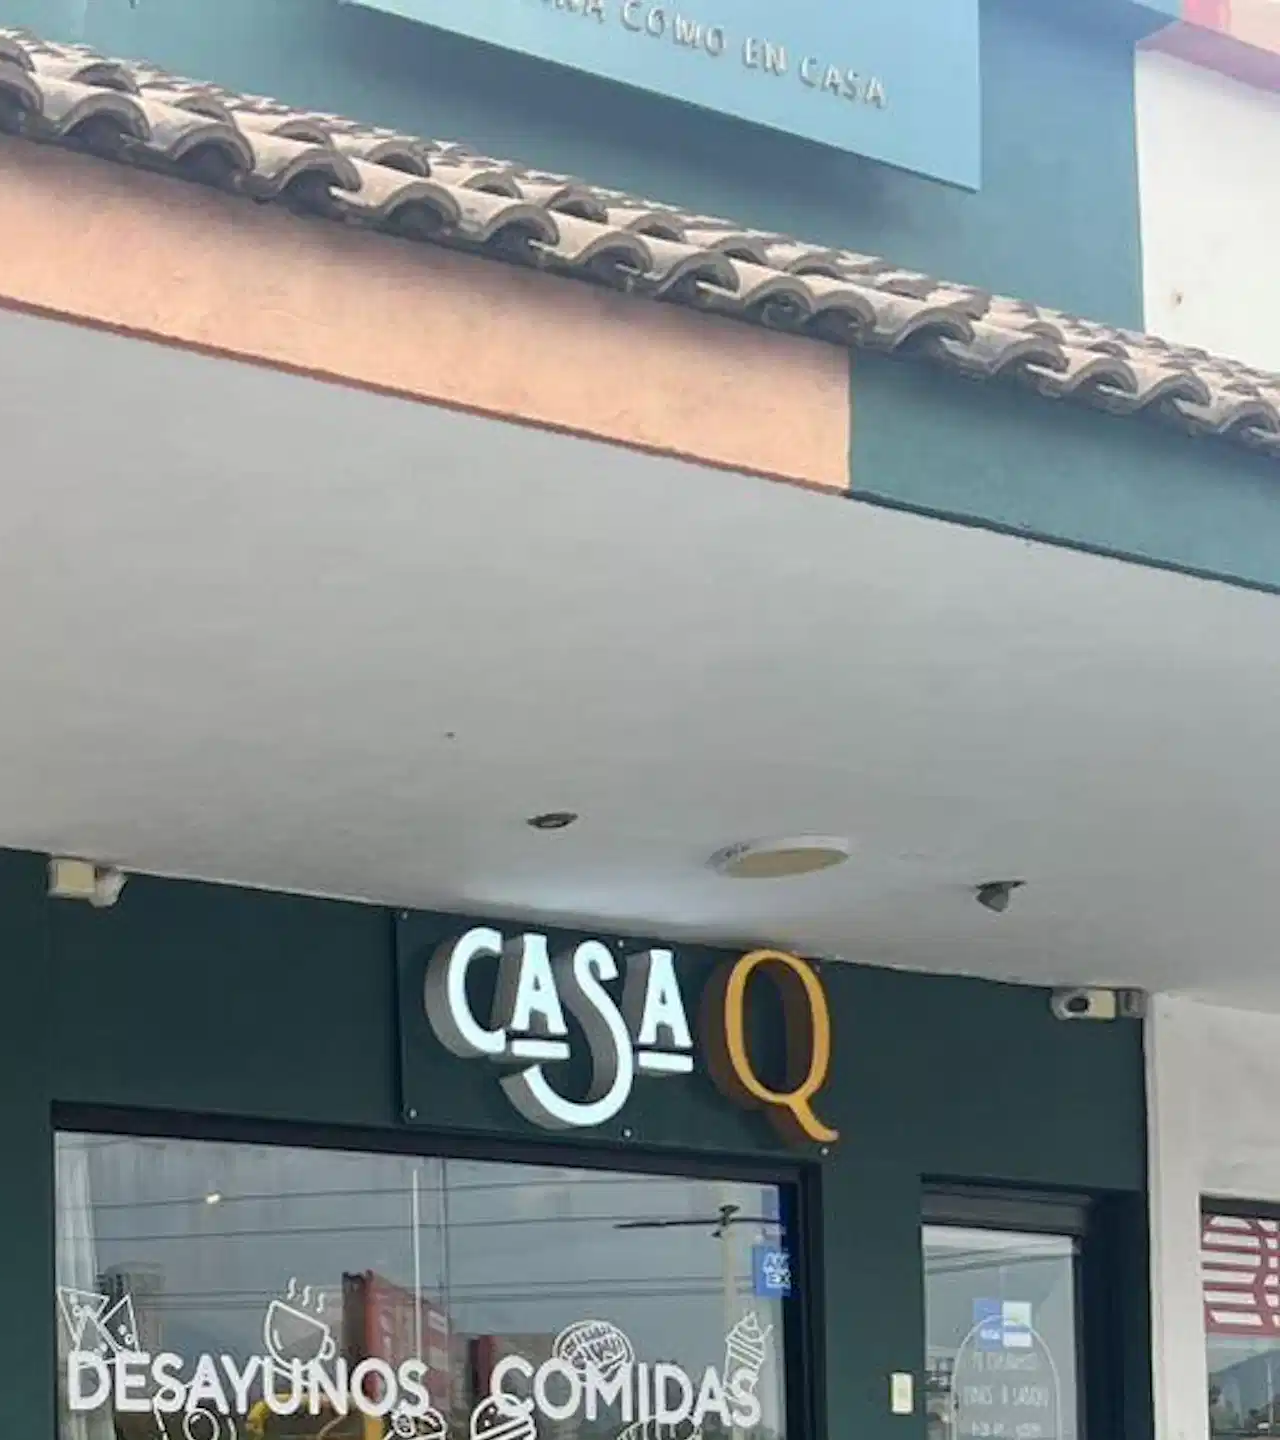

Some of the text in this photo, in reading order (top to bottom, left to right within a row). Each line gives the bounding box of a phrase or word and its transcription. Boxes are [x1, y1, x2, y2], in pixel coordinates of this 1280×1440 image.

[622, 1, 727, 57] COMO
[744, 36, 789, 77] EN
[798, 55, 888, 109] CASA
[440, 926, 839, 1142] CASA Q
[68, 1350, 762, 1427] DESAYUNOS COMIDAS
